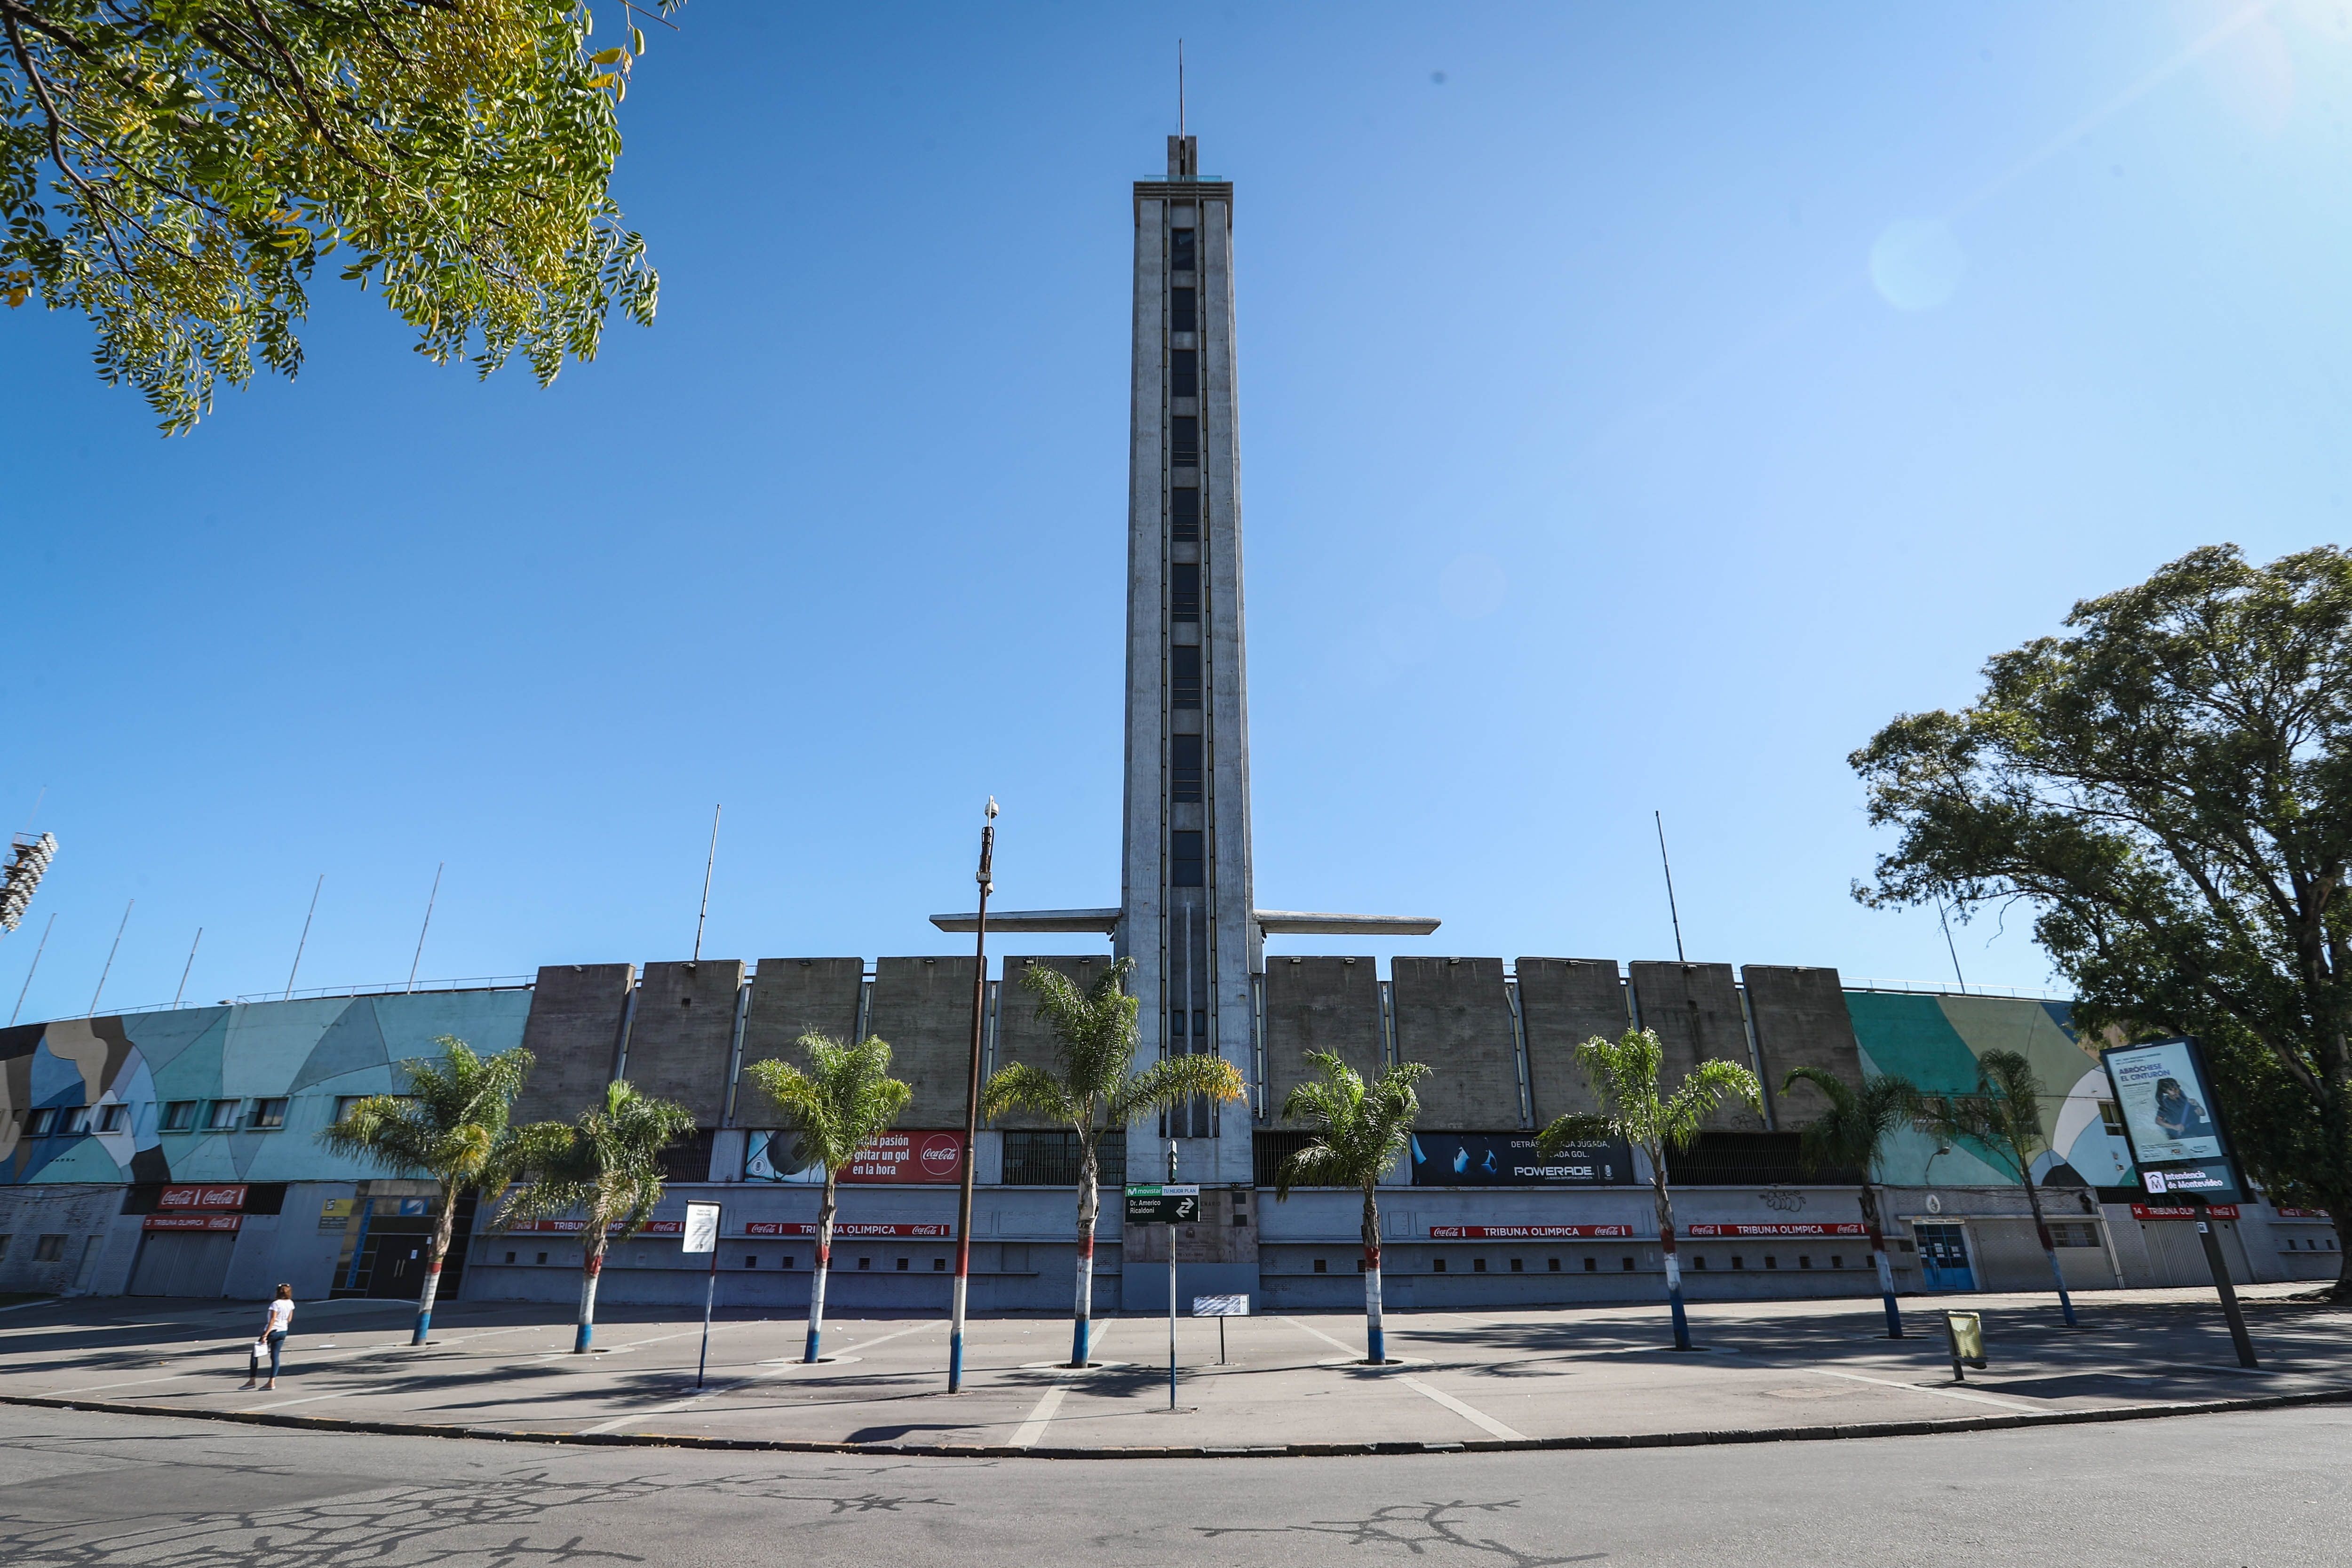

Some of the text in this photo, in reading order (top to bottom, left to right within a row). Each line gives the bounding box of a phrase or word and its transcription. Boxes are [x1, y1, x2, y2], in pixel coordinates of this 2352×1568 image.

[870, 1134, 877, 1146] la
[880, 1134, 908, 1148] pasión
[855, 1148, 909, 1162] gritar un gol
[922, 1148, 957, 1160] Coca-Cola
[852, 1163, 896, 1175] en la hora
[1514, 1166, 1592, 1176] POWERADE
[2164, 1170, 2207, 1181] Intendencia
[2177, 1179, 2224, 1188] Montevideo
[161, 1190, 194, 1205] Coca-Cola
[202, 1189, 237, 1205] Coca-Cola
[208, 1218, 232, 1228] Coca-Cola
[653, 1222, 677, 1232] Coca-Cola
[752, 1224, 938, 1235] Coca-Cola TRINA OLIMPICA Coca-Cola
[1434, 1226, 1619, 1237] Coca-Cola TRIBUNA OLIMPICA Coca-Cola
[1692, 1224, 1858, 1235] Coca-Cola TRIBUNA OLIMPICA Coca-Cola
